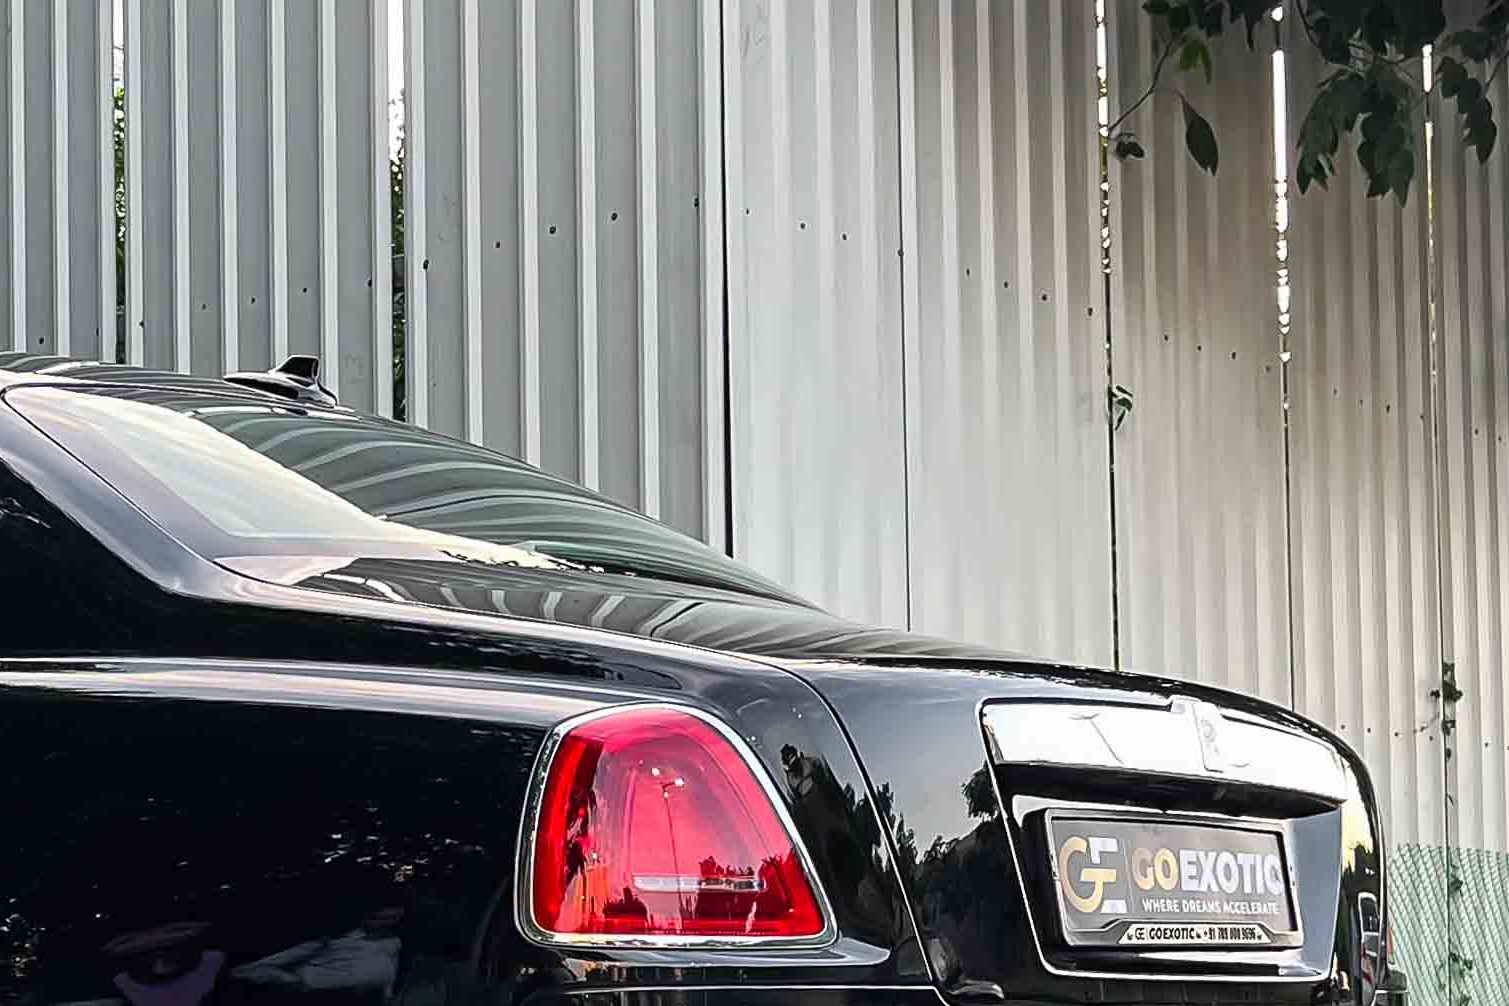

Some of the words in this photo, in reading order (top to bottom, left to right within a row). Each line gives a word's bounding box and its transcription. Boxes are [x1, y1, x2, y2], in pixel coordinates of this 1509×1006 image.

[1131, 848, 1285, 895] GOEXOTIC
[1141, 897, 1180, 912] WHERE
[1181, 898, 1221, 914] DREAMS
[1224, 900, 1279, 915] ACCELERATE
[1148, 927, 1195, 940] GOEXOTIC
